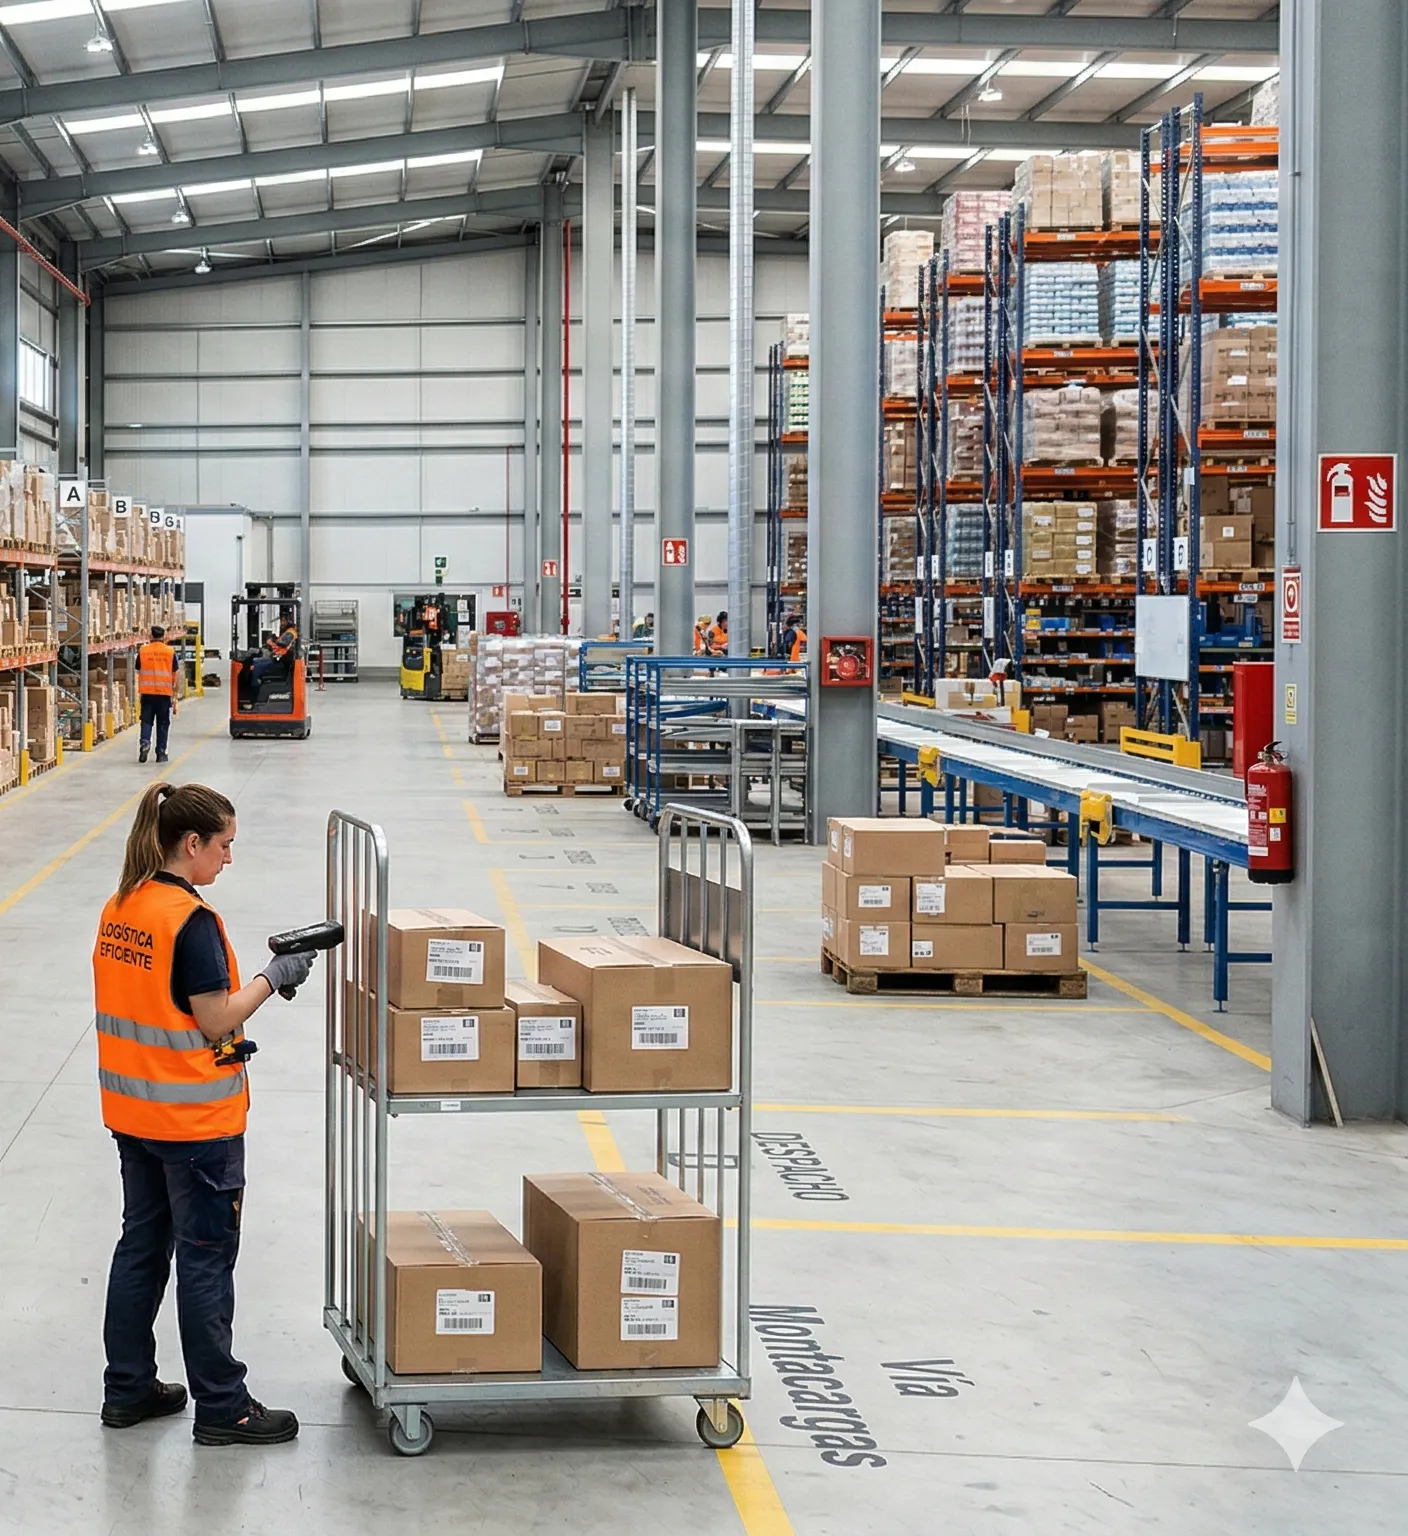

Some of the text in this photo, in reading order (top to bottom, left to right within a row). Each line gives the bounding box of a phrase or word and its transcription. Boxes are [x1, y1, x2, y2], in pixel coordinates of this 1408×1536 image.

[66, 486, 81, 502] A
[115, 500, 127, 513] B
[149, 511, 160, 524] B
[102, 922, 153, 950] LOGÍSTICA
[100, 941, 152, 970] EFICIENTE
[750, 1132, 850, 1201] DESPACHO
[749, 1304, 887, 1468] Montacargas
[880, 1359, 975, 1397] Vía
